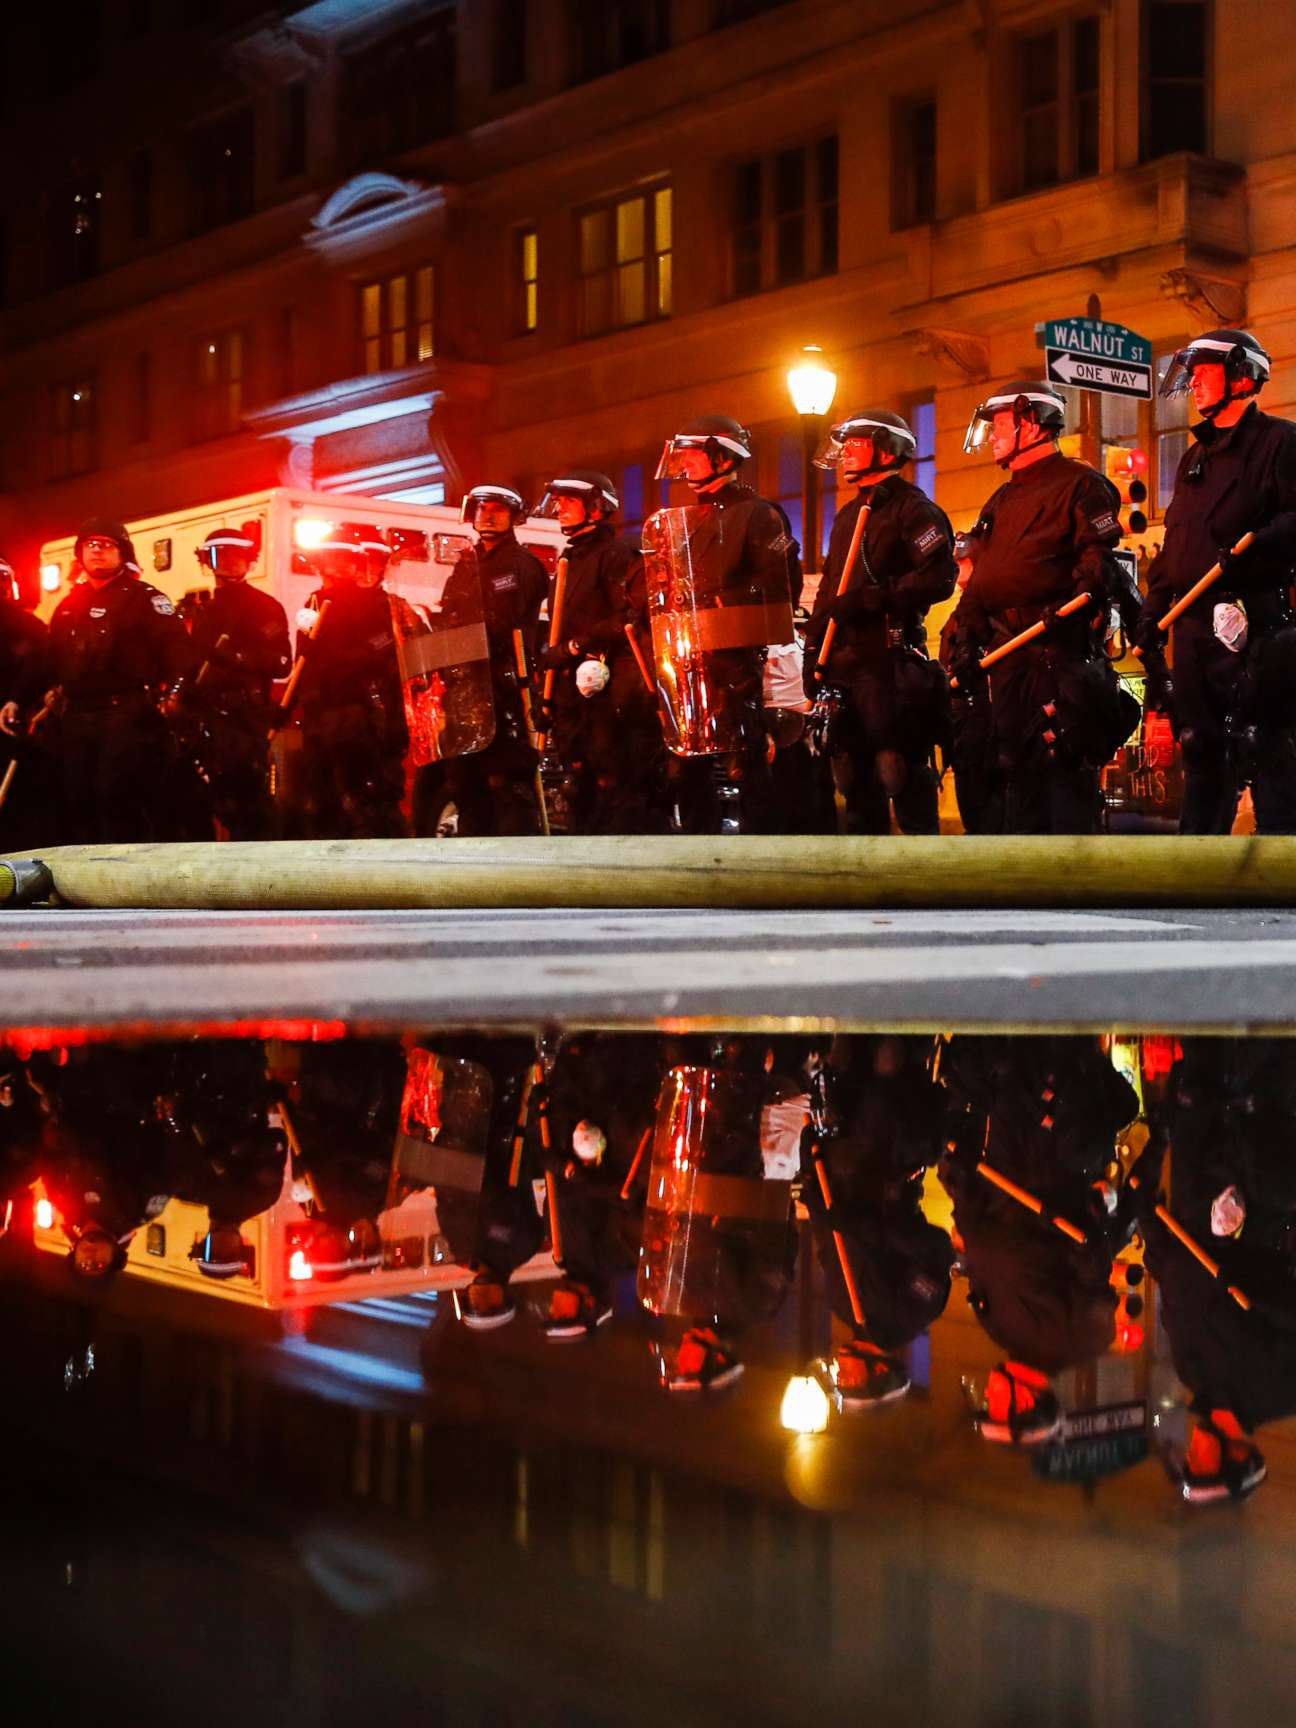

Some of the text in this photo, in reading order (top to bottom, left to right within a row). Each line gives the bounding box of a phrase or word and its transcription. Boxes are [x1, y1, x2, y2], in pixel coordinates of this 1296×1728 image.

[1054, 325, 1144, 361] WALNUT ST
[1076, 364, 1137, 387] ONE WAY
